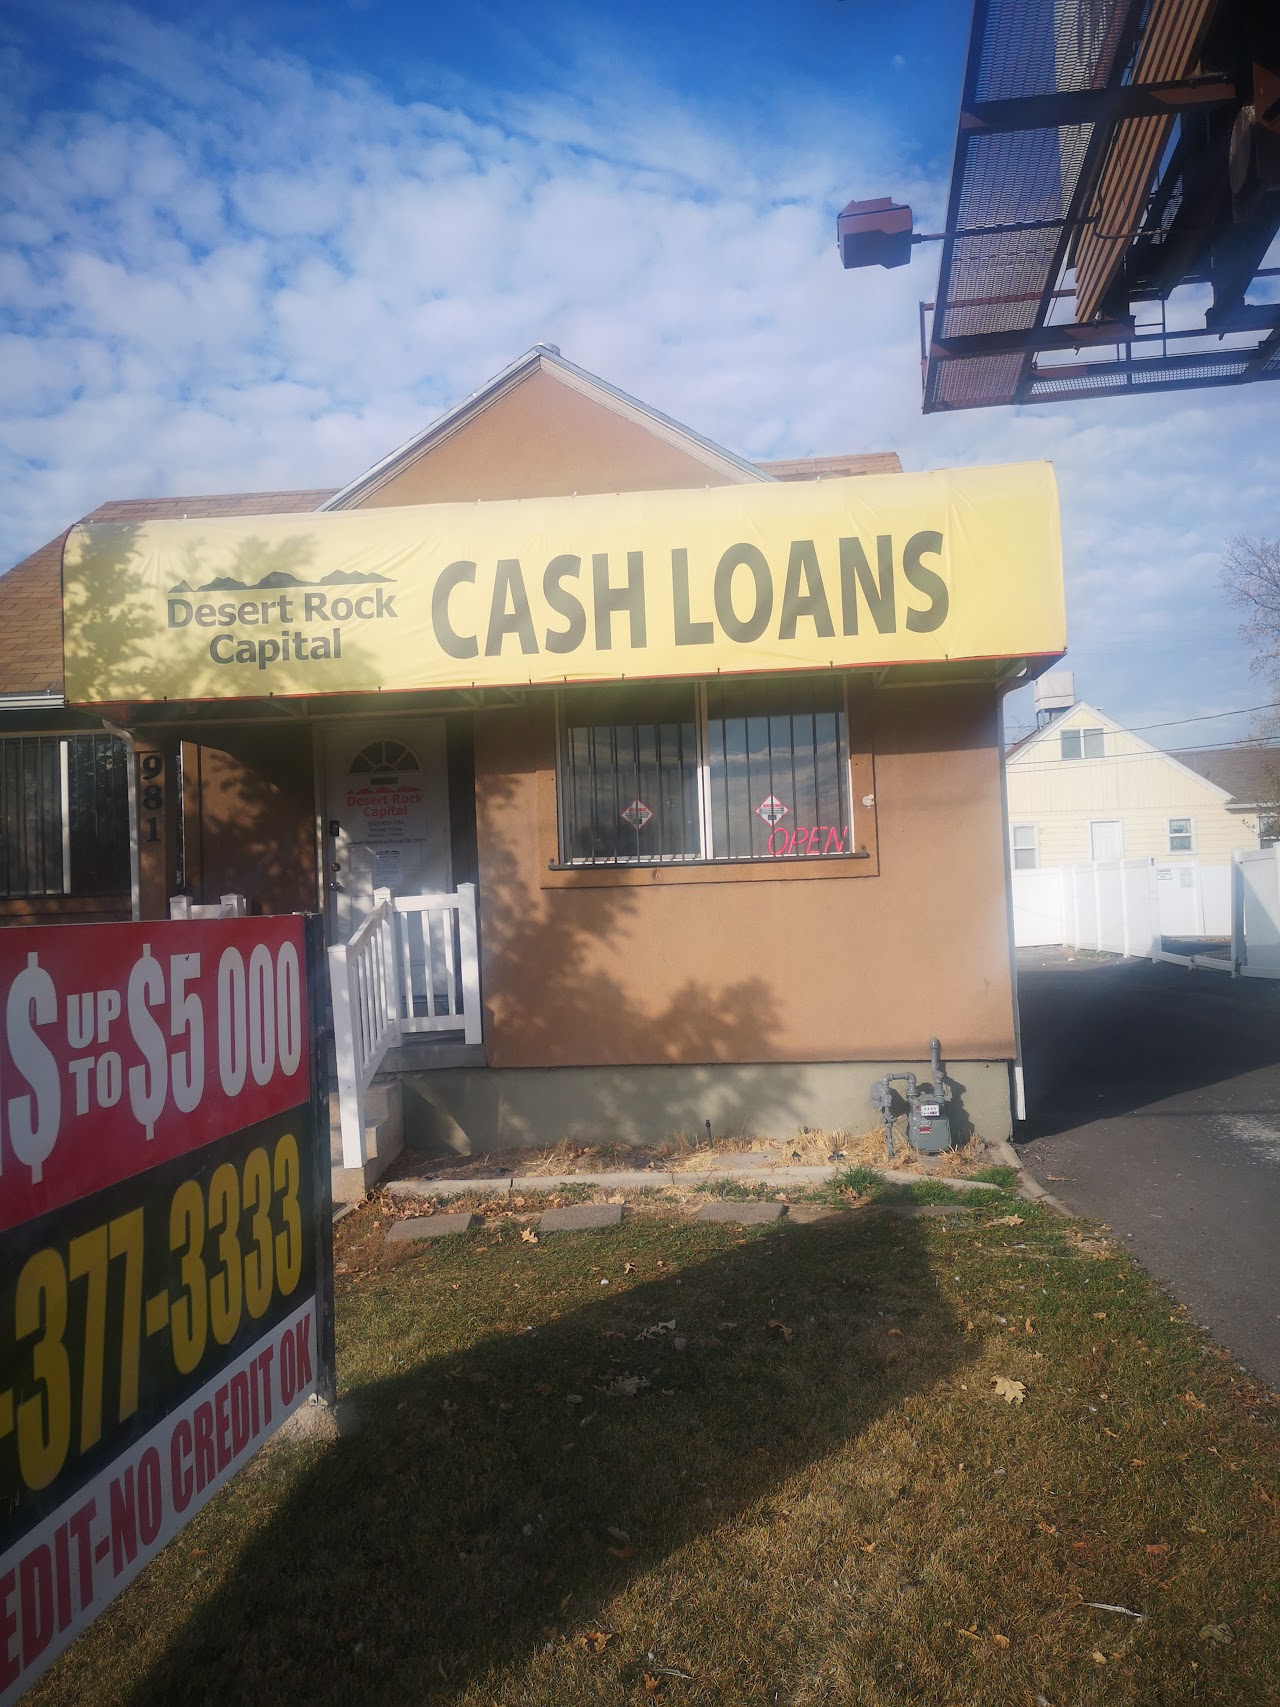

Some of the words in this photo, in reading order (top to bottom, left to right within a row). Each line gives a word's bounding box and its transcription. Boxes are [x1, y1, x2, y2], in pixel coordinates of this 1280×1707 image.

[168, 595, 294, 628] Desert
[304, 588, 399, 622] Rock
[431, 551, 647, 659] CASH
[671, 530, 950, 646] LOANS
[209, 628, 342, 670] Capital
[143, 755, 163, 843] 981
[347, 795, 389, 807] Desert
[392, 792, 424, 805] Rock
[363, 804, 409, 819] Capital
[768, 826, 849, 855] OPEN
[67, 989, 122, 1049] UP
[68, 1051, 123, 1117] TO
[170, 1343, 275, 1514] CREDIT
[280, 1313, 314, 1407] OK
